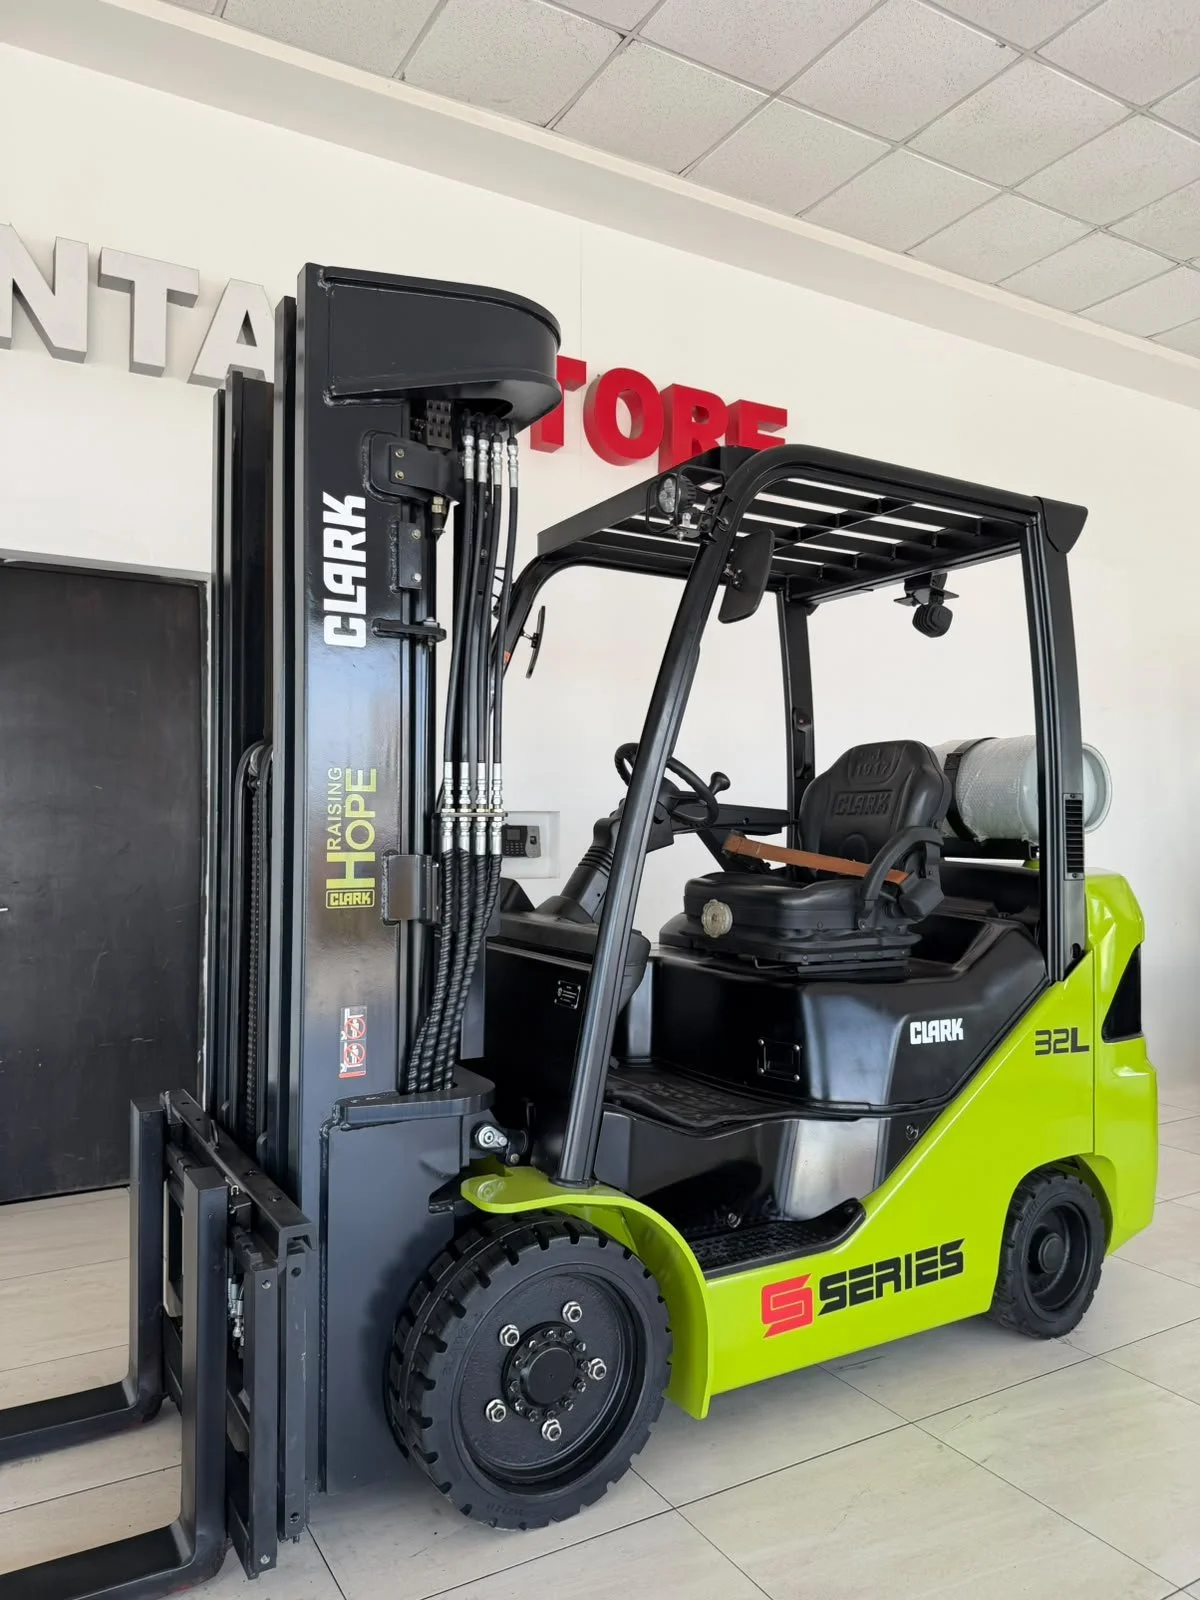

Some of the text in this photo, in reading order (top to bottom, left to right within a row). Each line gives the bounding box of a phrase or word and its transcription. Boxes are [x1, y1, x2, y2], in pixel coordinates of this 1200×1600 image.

[322, 491, 367, 648] CLARK
[326, 767, 342, 850] RAISING
[326, 768, 377, 889] HOPE
[329, 891, 371, 906] CLARK
[909, 1018, 964, 1045] CLARK
[1035, 1027, 1090, 1056] 32L
[818, 1238, 966, 1317] SERIES
